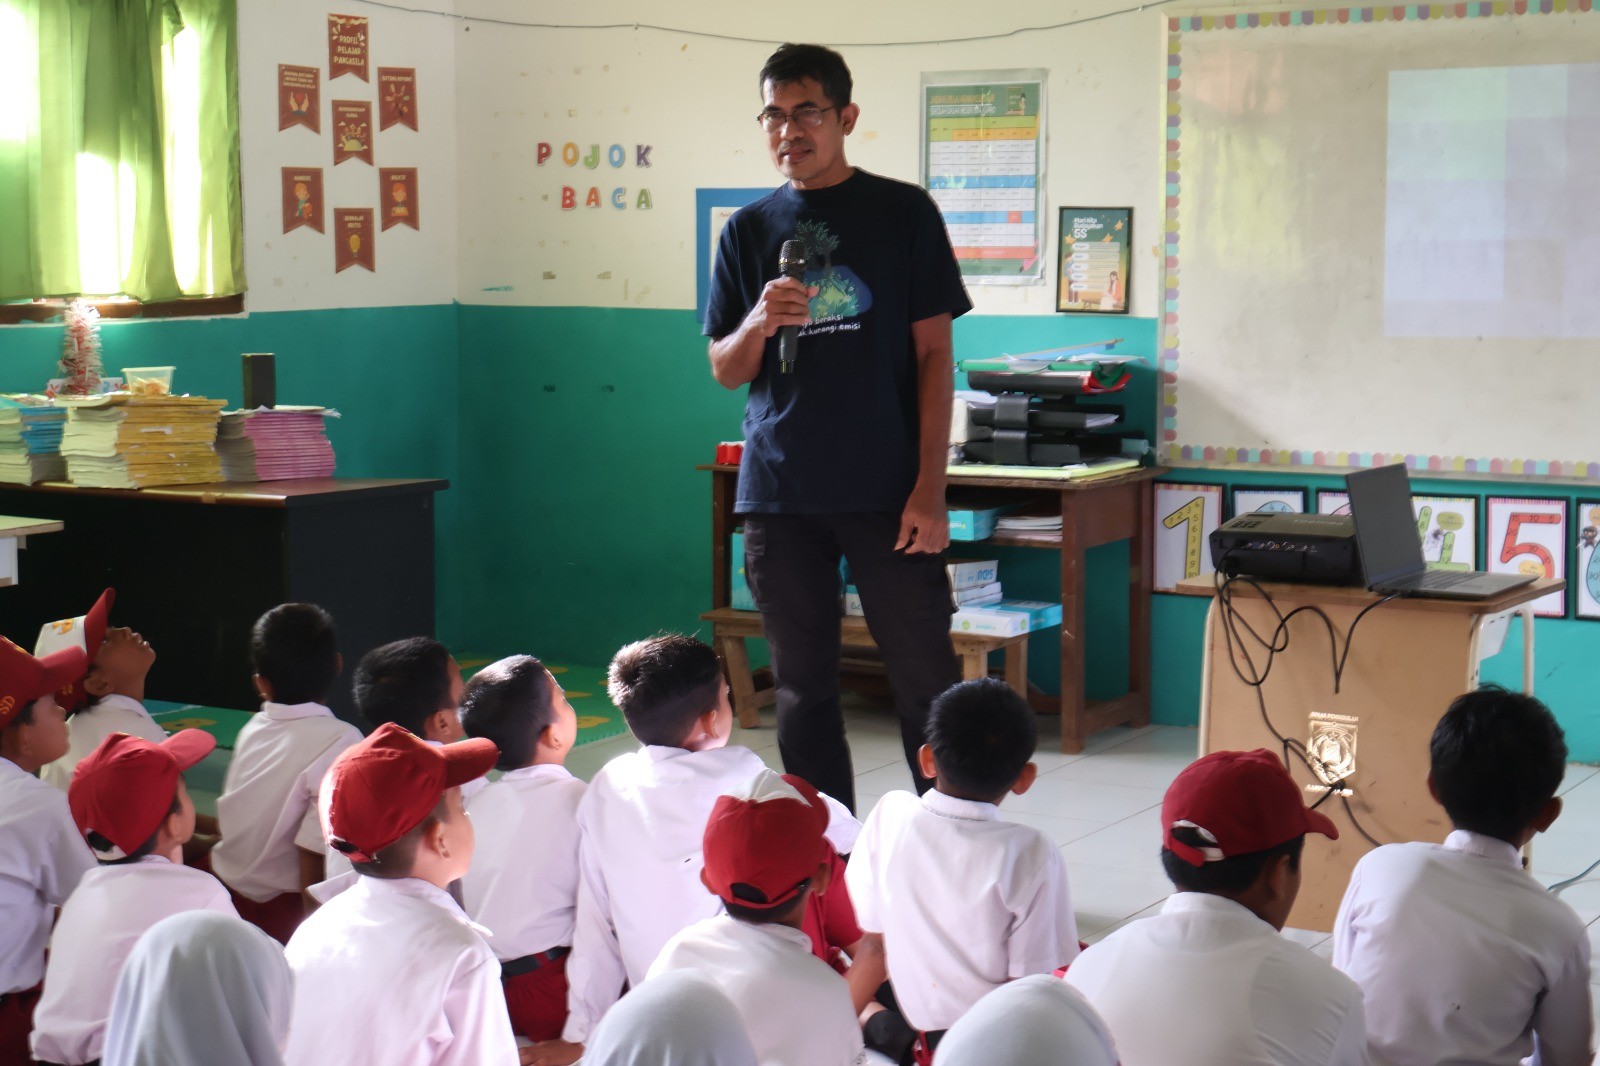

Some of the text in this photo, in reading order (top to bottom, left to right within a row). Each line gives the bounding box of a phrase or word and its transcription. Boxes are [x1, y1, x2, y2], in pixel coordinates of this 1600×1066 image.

[339, 35, 359, 45] PROFIL
[337, 45, 361, 55] PELAJAR
[333, 56, 365, 66] PANCASILA
[536, 141, 653, 170] POJOK
[561, 185, 653, 210] BACA
[1073, 228, 1088, 239] 5S
[815, 313, 844, 325] beraksi
[808, 323, 837, 335] kurangi
[838, 321, 861, 331] emisi
